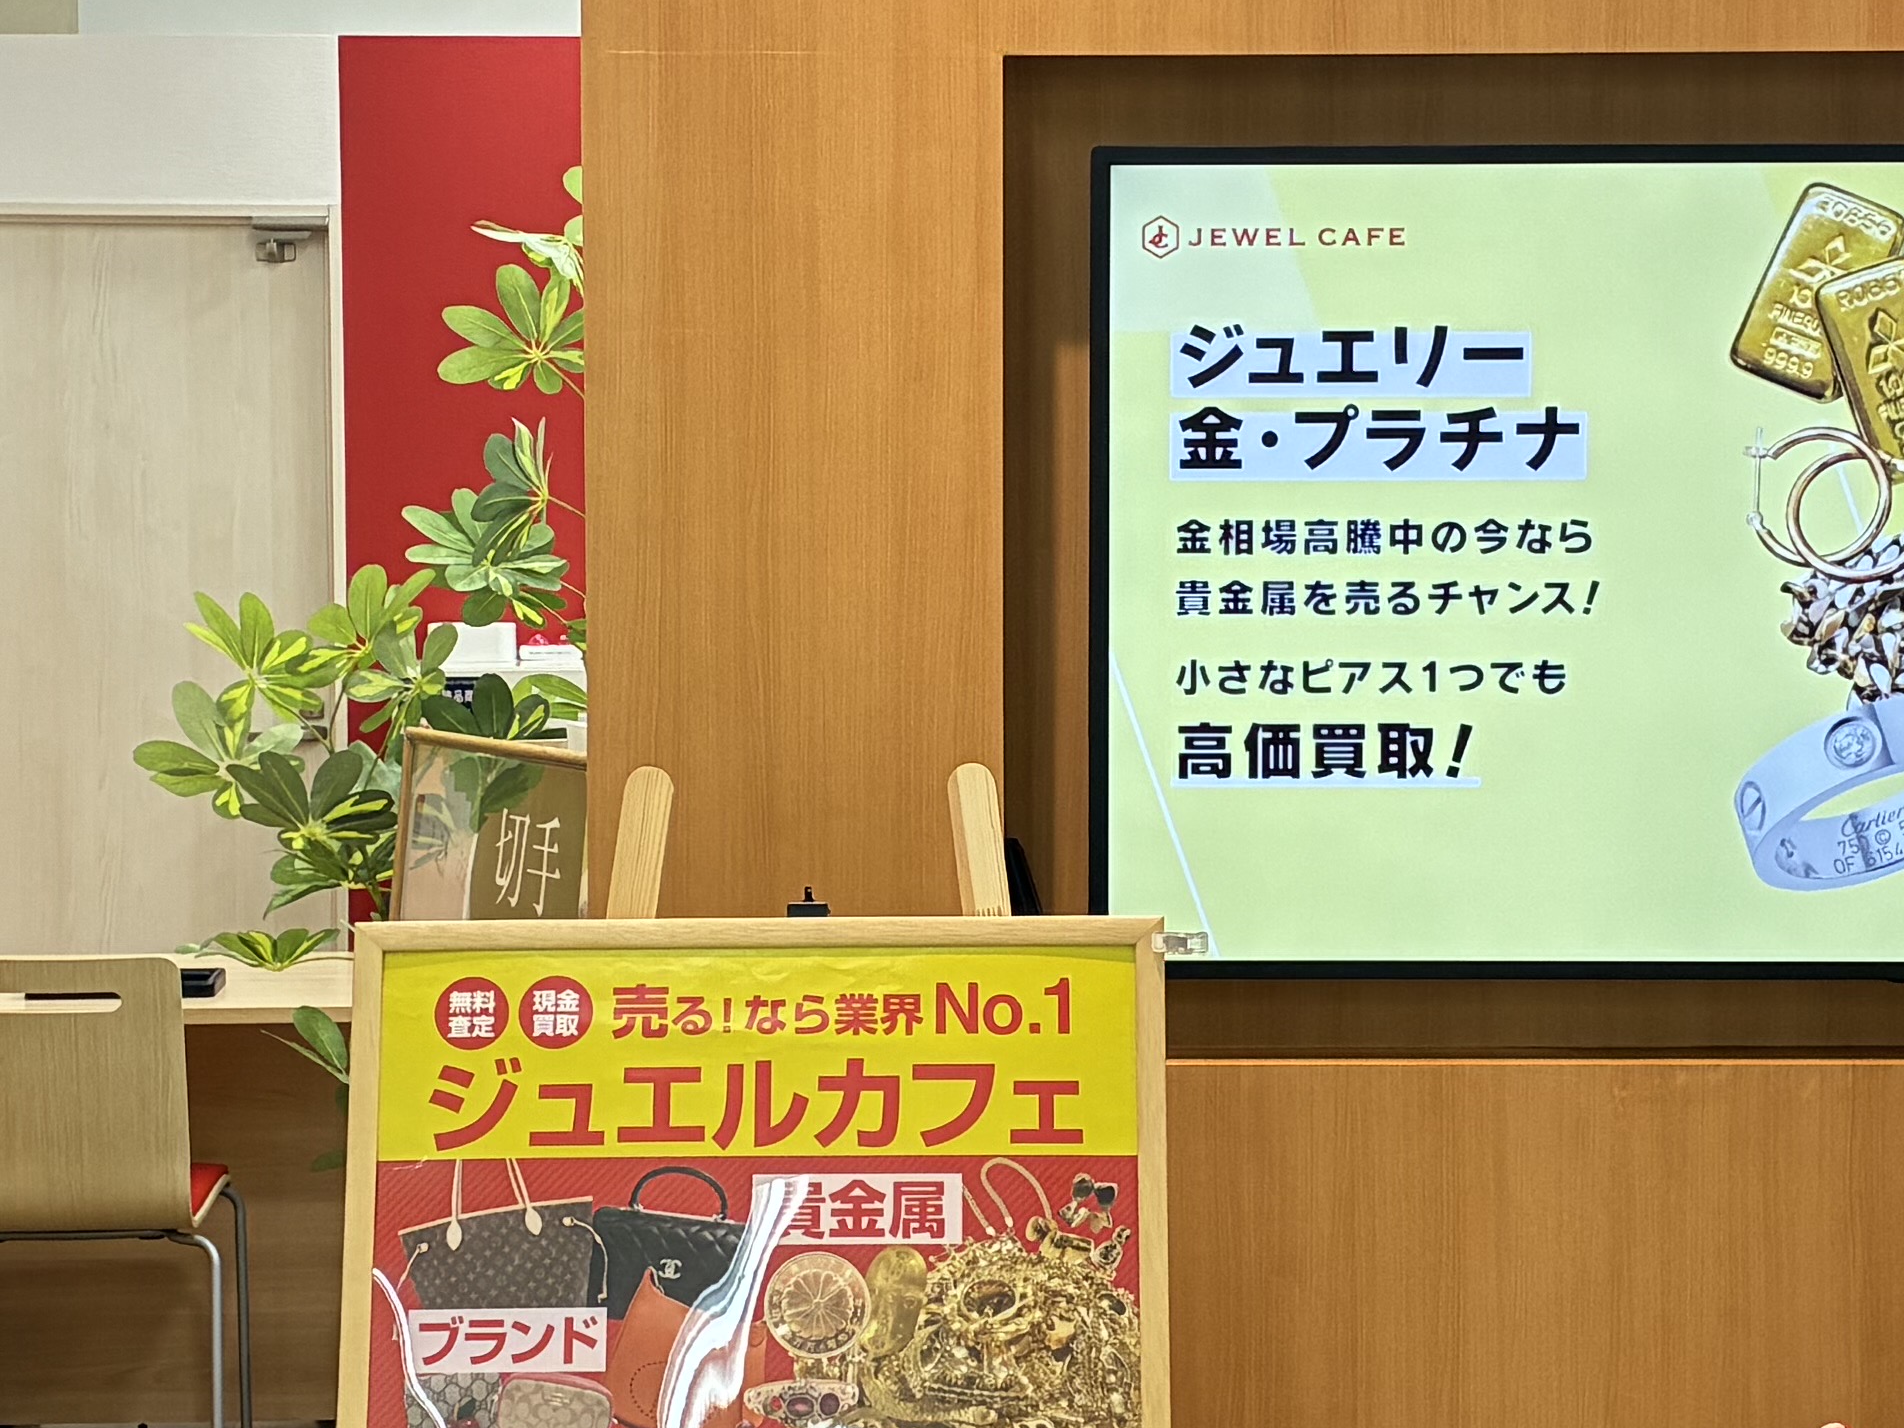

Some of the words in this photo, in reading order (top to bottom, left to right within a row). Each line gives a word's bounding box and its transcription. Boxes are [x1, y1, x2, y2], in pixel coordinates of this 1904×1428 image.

[1188, 227, 1306, 247] JEWEL
[1318, 227, 1406, 247] CAFE
[1180, 324, 1524, 389] ジュエリー
[1178, 403, 1580, 472] 金・プラチナ
[1176, 518, 1592, 556] 金相場高騰中の今なら
[1175, 658, 1567, 696] 小さなピアス1つでも
[1177, 722, 1474, 780] 高価買取！
[496, 807, 561, 917] 切手
[448, 988, 497, 1013] 無料
[532, 988, 581, 1013] 現金
[448, 1014, 497, 1039] 査定
[532, 1014, 581, 1040] 買取
[427, 1057, 1085, 1151] ジュエルカフェ
[780, 1180, 945, 1239] 貴金属
[417, 1315, 603, 1366] ブランド
